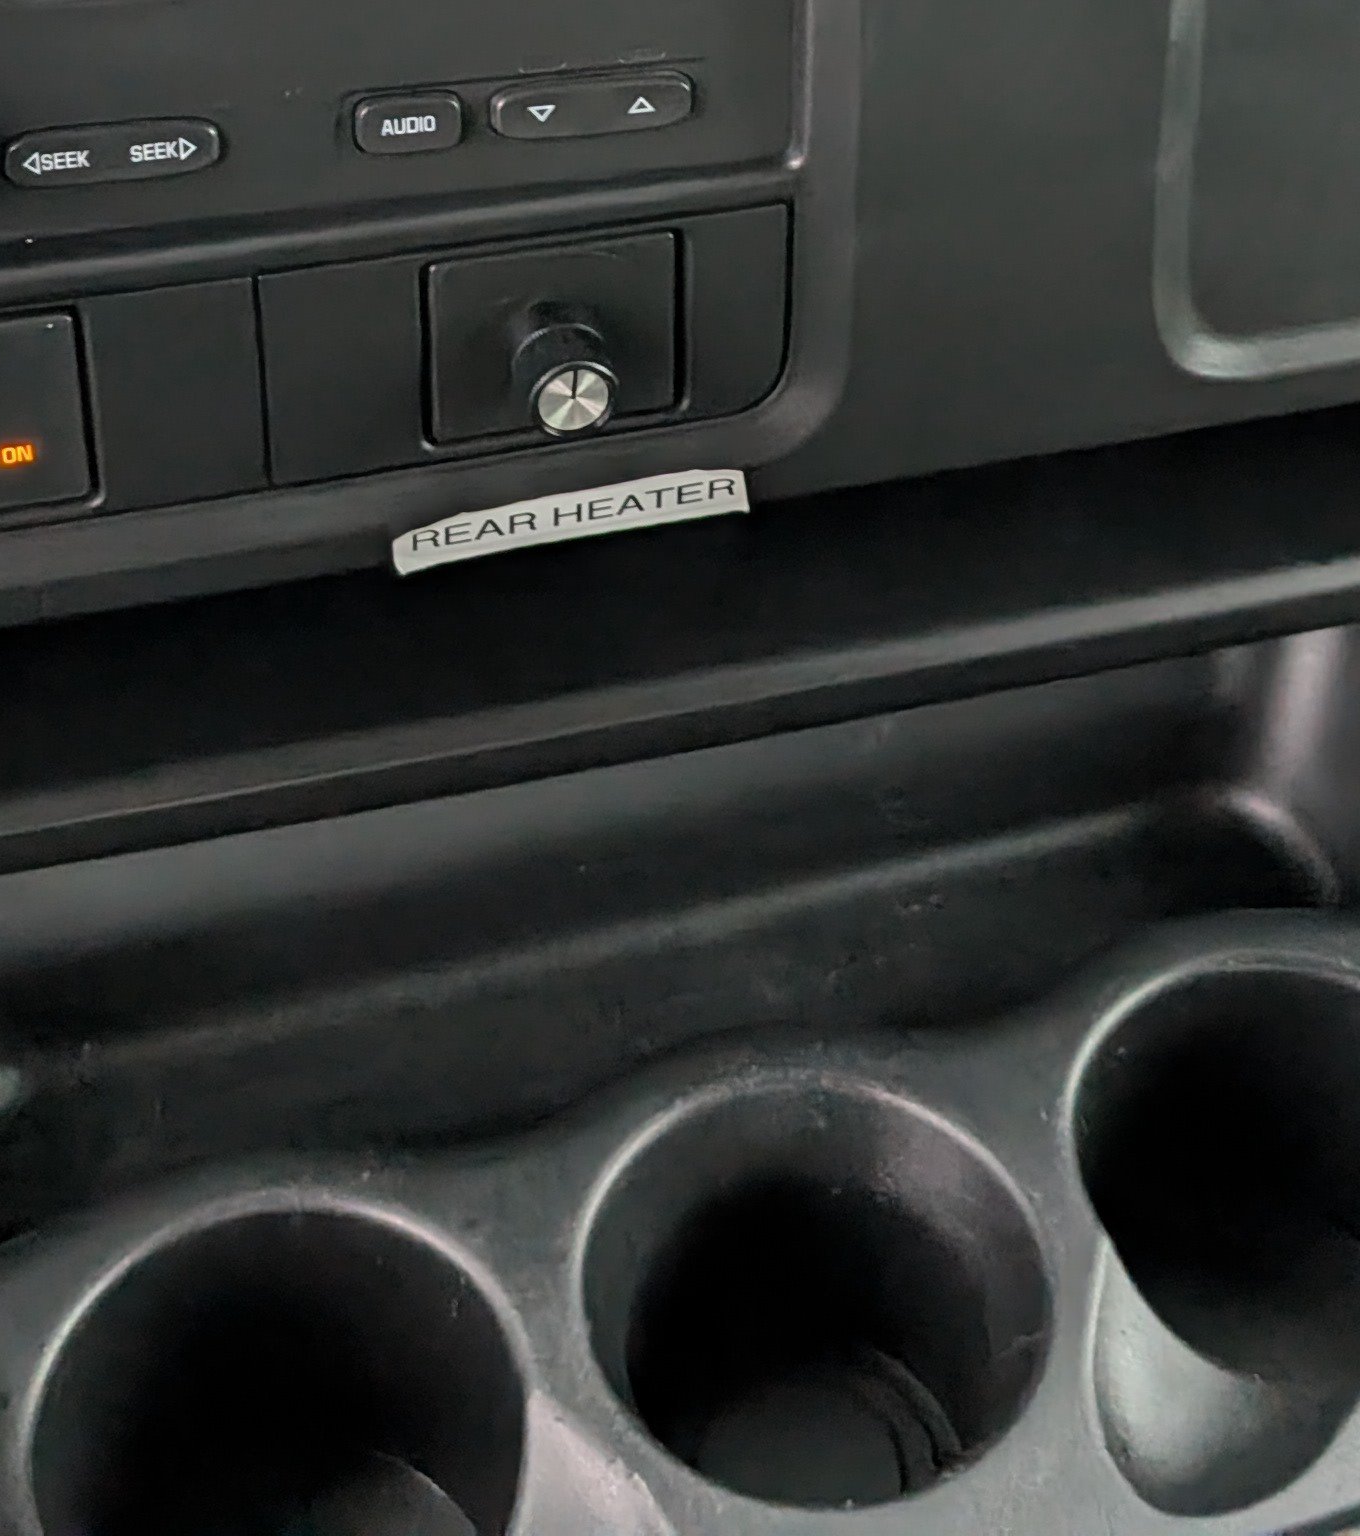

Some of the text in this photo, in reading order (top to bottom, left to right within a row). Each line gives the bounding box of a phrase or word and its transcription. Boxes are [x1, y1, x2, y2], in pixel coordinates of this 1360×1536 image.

[381, 115, 437, 136] AUDIO
[40, 140, 178, 171] SEEK SEEK
[1, 444, 33, 464] ON
[411, 477, 736, 552] REAR HEATER
